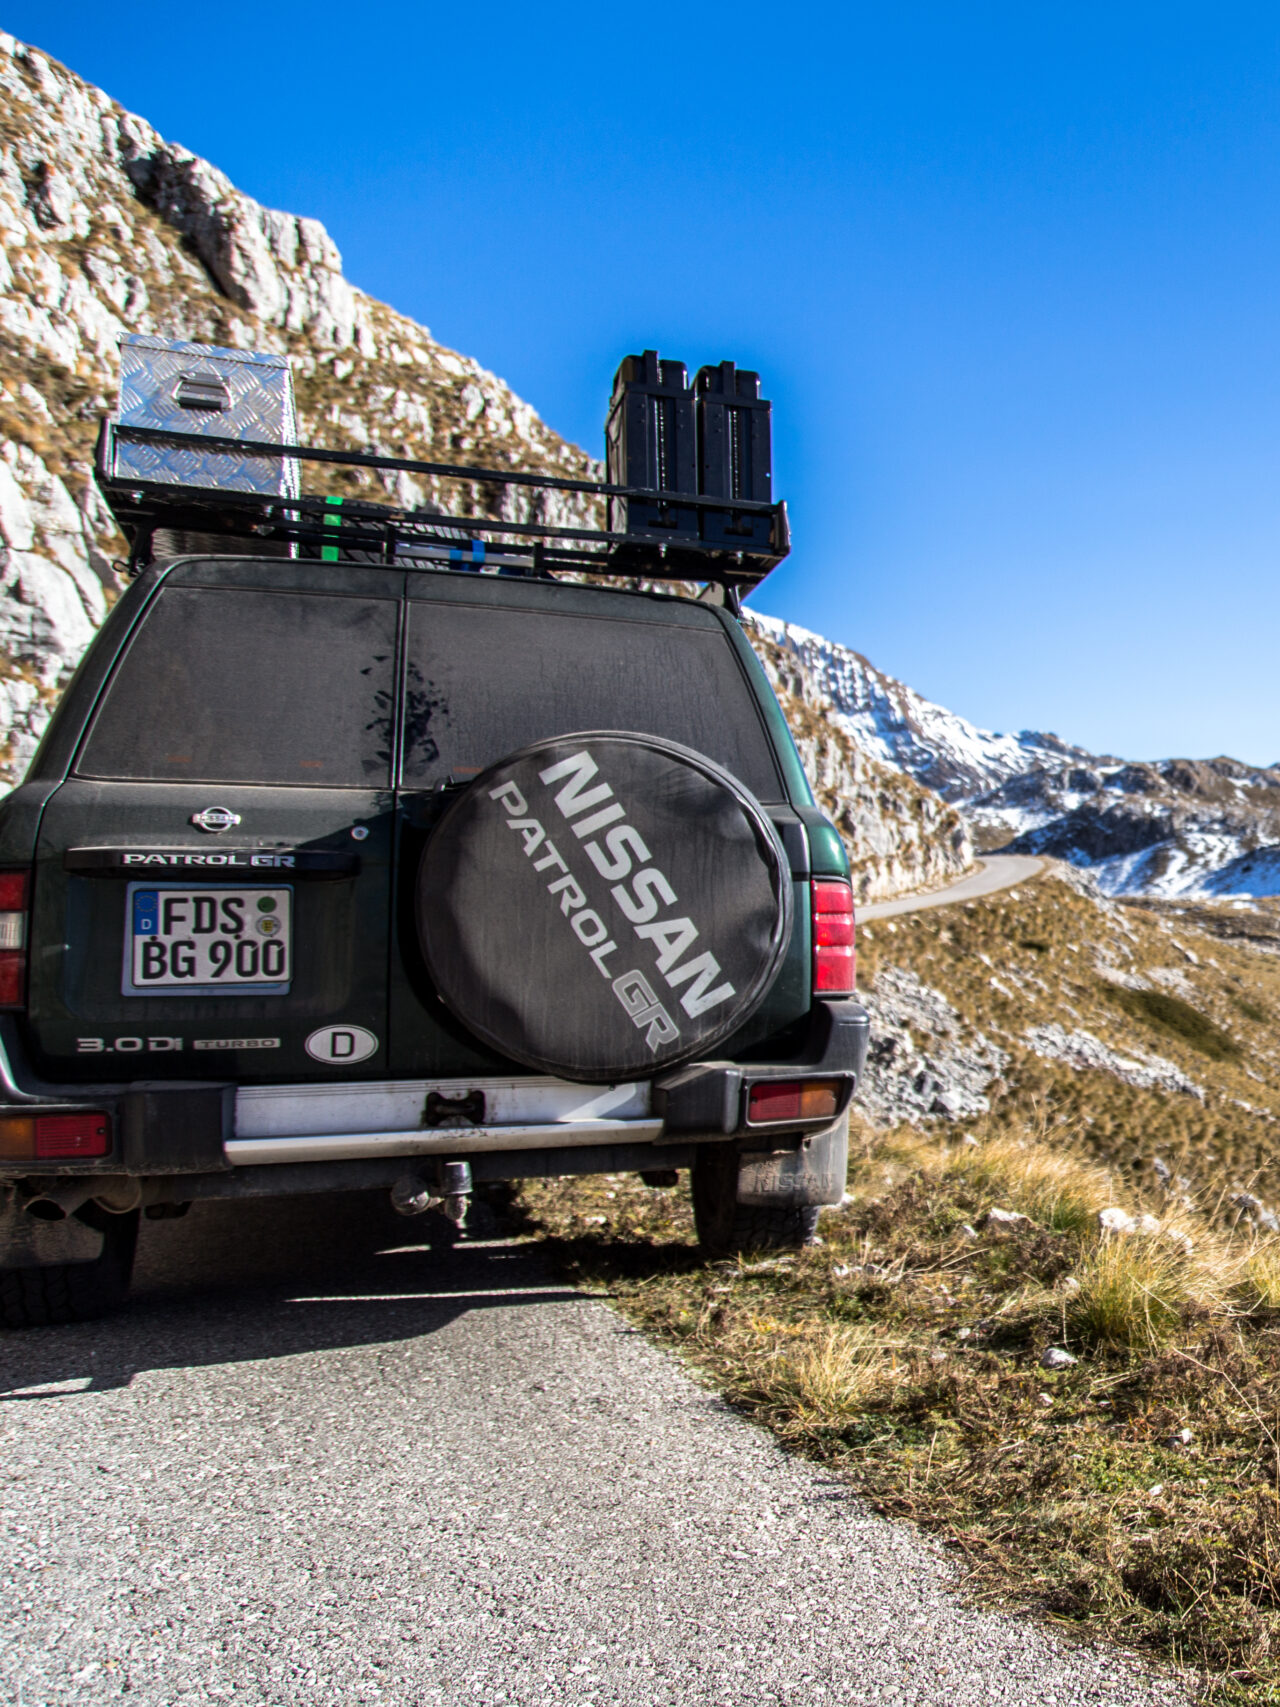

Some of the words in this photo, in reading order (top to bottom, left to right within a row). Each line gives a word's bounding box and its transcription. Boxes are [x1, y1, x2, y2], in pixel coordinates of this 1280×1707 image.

[123, 854, 247, 865] PATROL
[250, 855, 296, 868] GR
[538, 750, 736, 1019] NISSAN
[141, 918, 153, 930] D
[163, 896, 245, 935] FDS
[488, 780, 618, 979] PATROL
[612, 969, 681, 1054] GR
[142, 940, 197, 979] BG
[208, 939, 286, 978] 900
[77, 1037, 143, 1052] 3.0
[200, 1039, 276, 1049] TURBO
[331, 1031, 356, 1058] D
